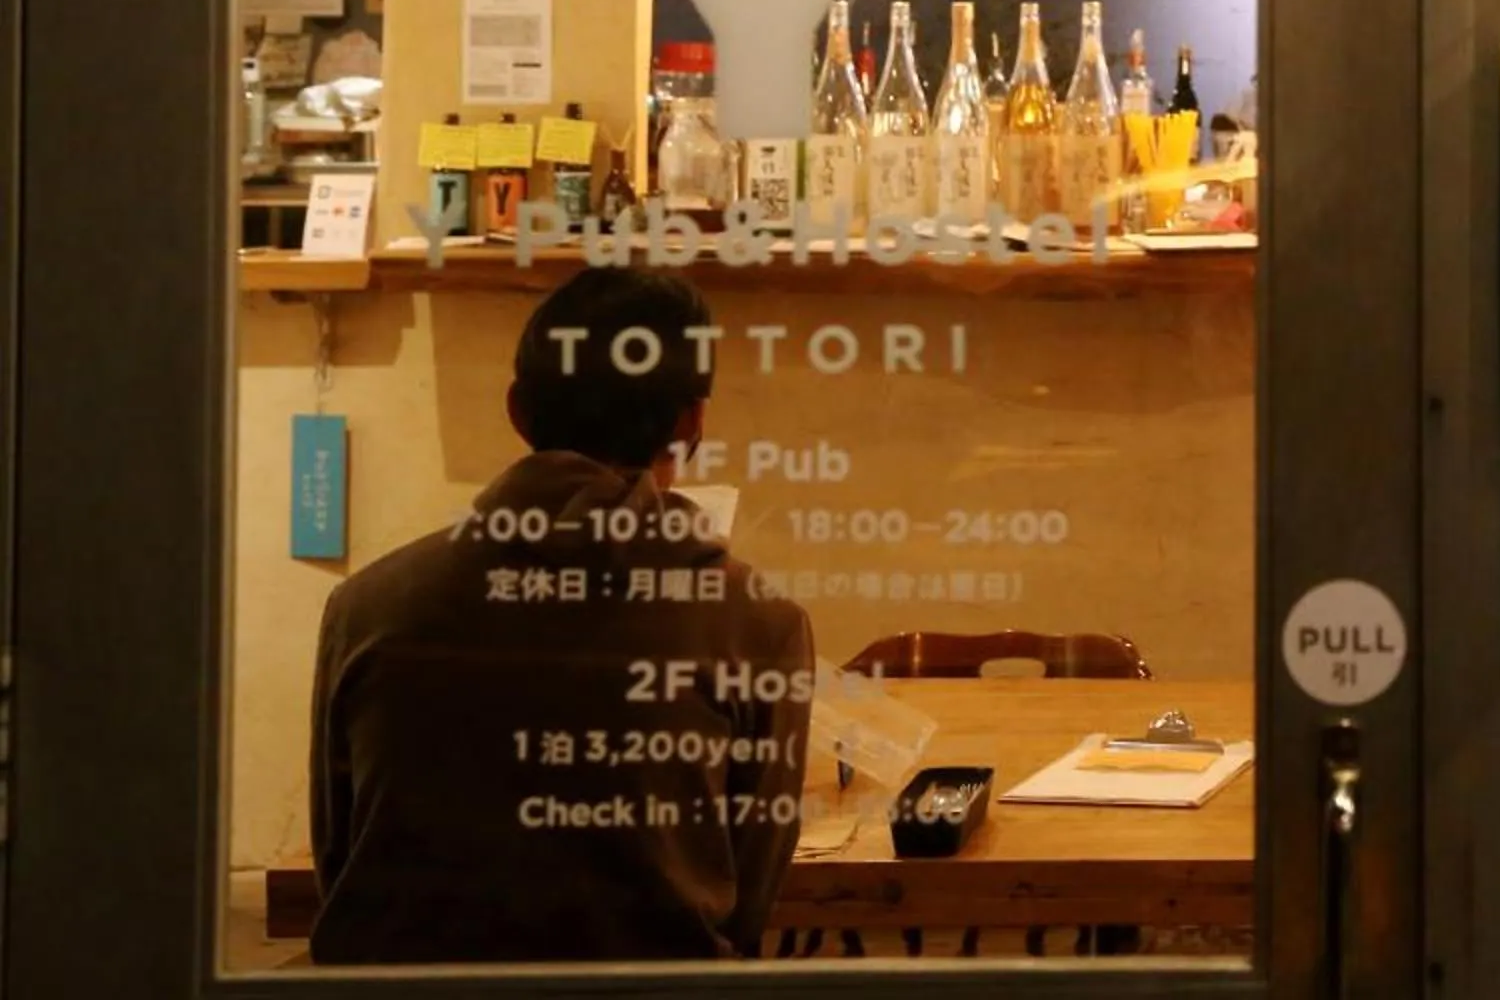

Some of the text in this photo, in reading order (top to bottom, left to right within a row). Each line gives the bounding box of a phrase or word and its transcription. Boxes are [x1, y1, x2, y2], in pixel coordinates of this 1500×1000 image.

[405, 198, 1108, 269] Y Pub&Hostel
[548, 326, 967, 376] TOTTORI
[667, 440, 851, 482] 1F Pub
[1298, 624, 1396, 655] PULL
[625, 660, 697, 702] 2F
[1332, 661, 1358, 688] 引
[519, 796, 635, 828] Check
[646, 794, 679, 826] in
